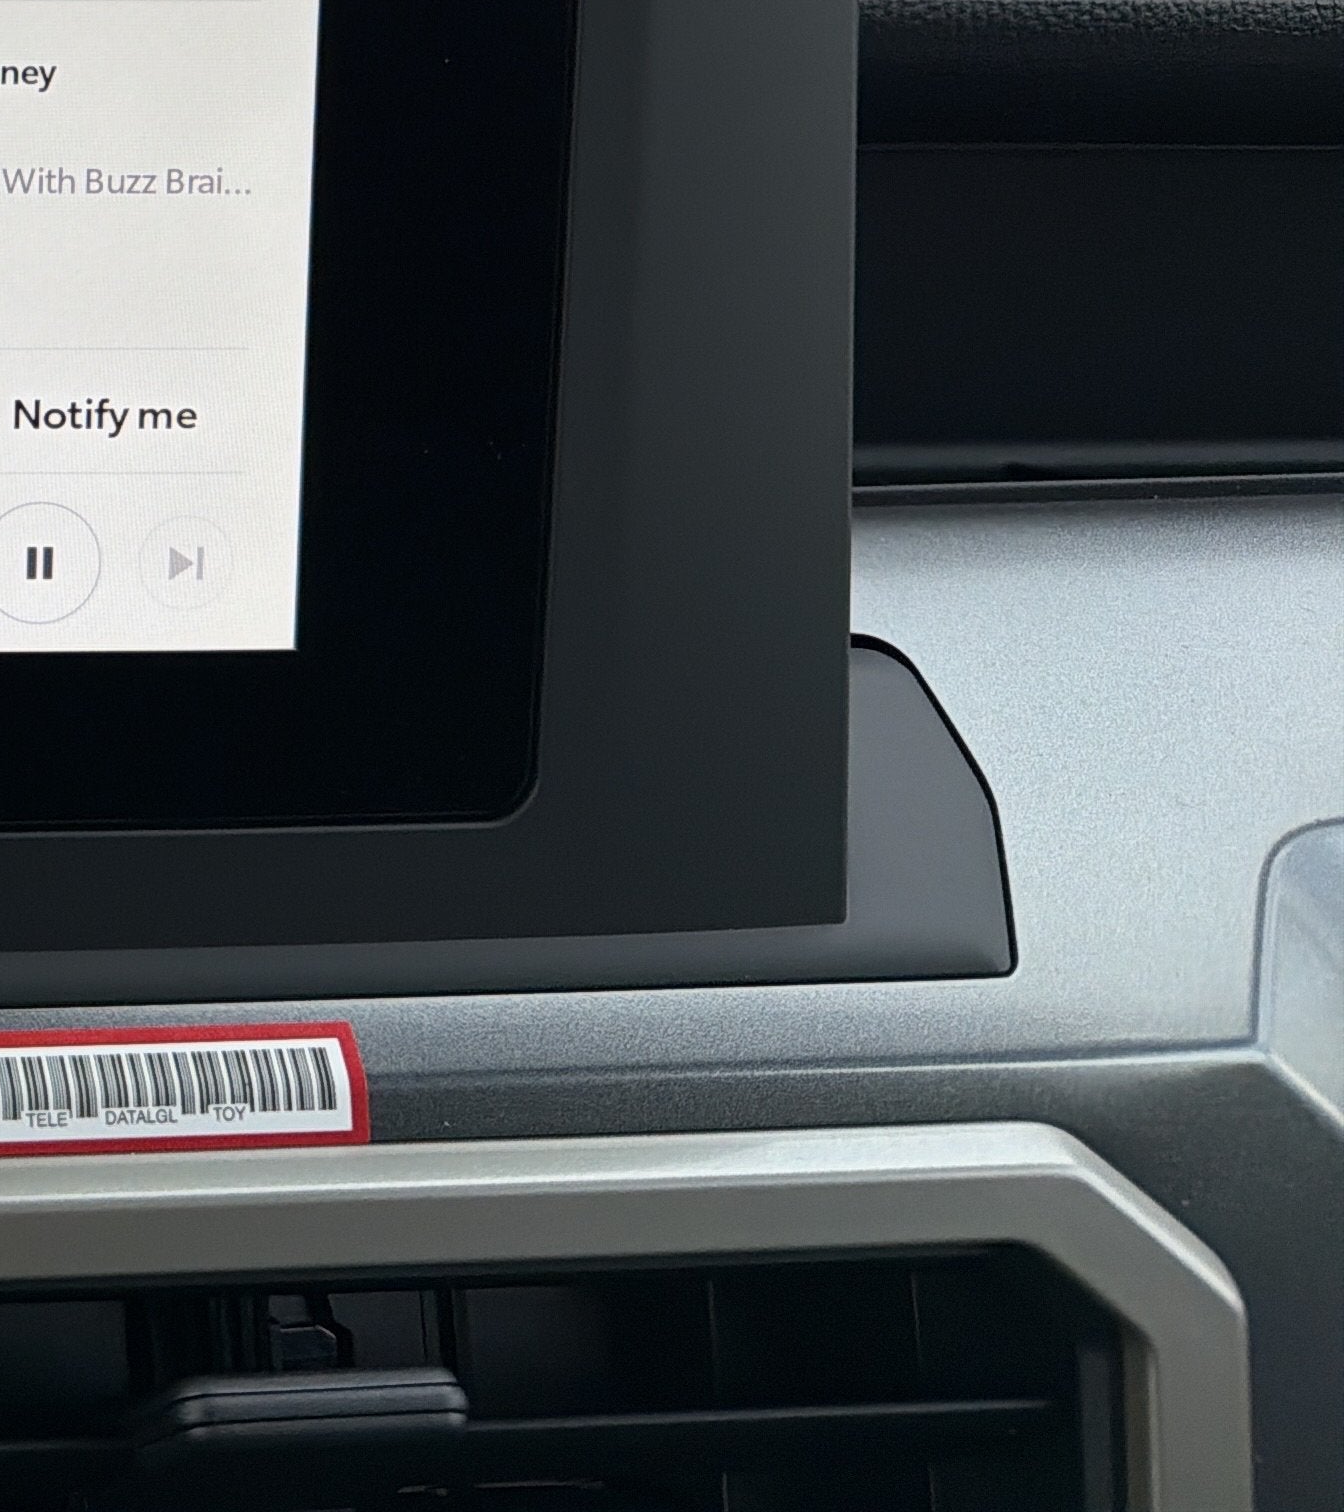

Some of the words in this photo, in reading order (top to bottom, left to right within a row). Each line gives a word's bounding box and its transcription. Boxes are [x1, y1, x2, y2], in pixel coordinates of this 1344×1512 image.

[3, 166, 74, 193] With
[85, 168, 156, 193] Buzz
[166, 166, 251, 194] Brai...
[13, 397, 129, 436] Notify
[138, 404, 197, 430] me
[26, 1110, 68, 1127] TELE
[105, 1105, 178, 1124] DATALGL
[213, 1103, 245, 1121] TOY
